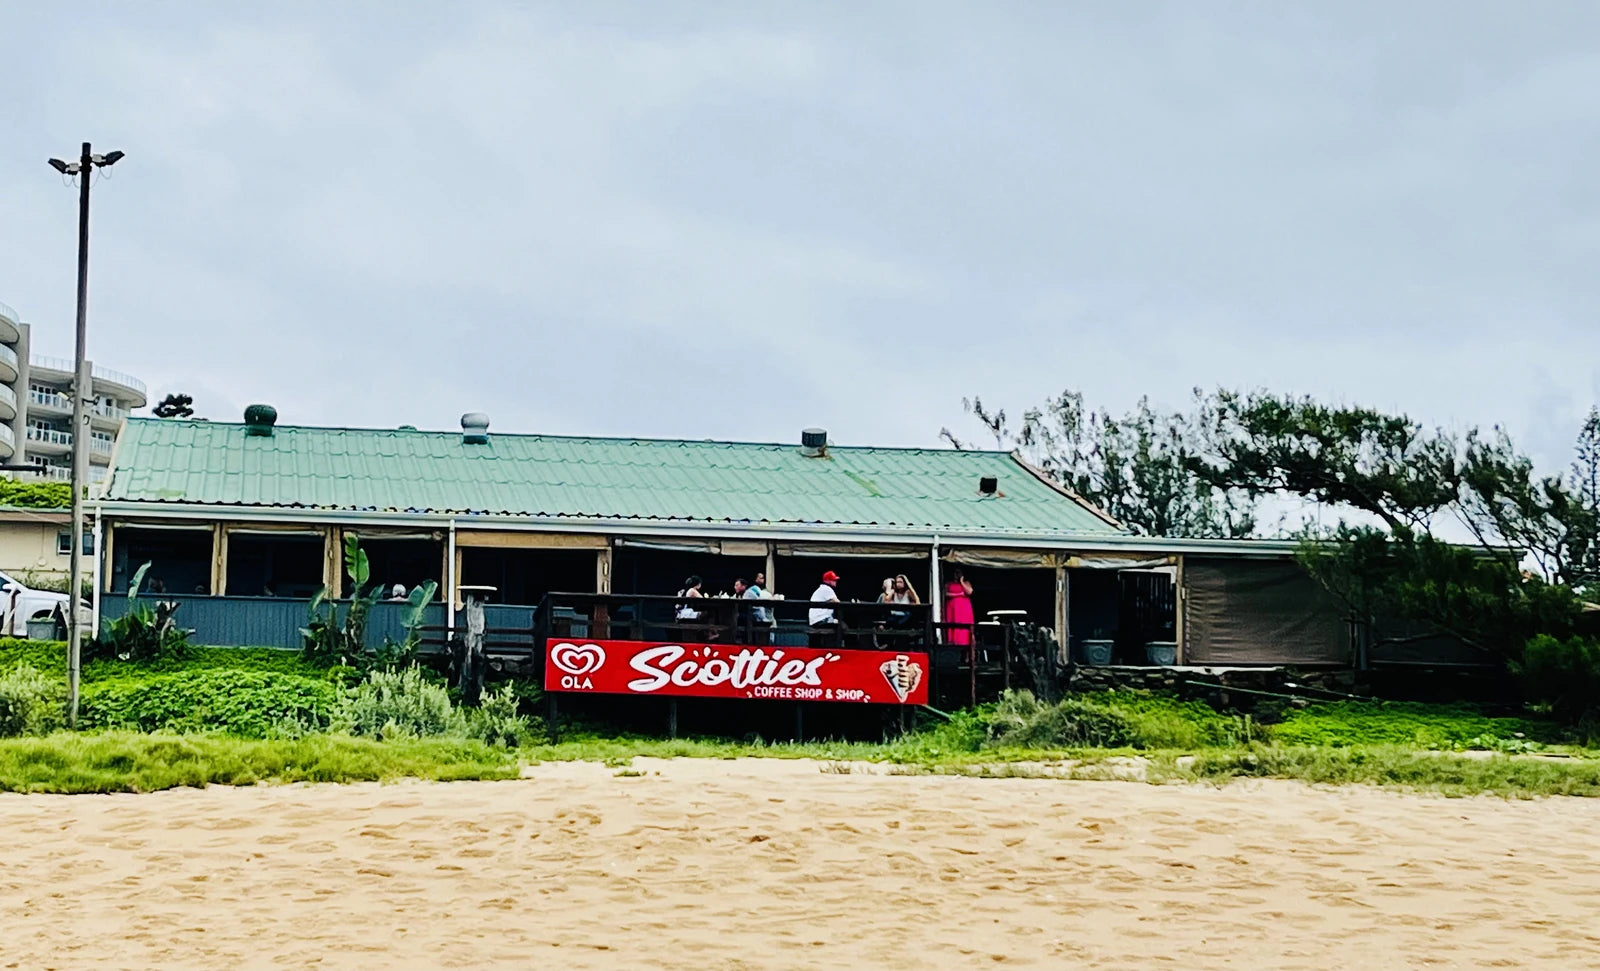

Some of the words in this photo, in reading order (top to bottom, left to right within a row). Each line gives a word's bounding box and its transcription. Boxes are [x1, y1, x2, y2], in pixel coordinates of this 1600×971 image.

[628, 645, 827, 692] Scotties
[561, 676, 594, 689] OLA
[754, 686, 792, 698] COFFEE
[795, 688, 823, 699] SHOP
[825, 689, 833, 699] &
[836, 689, 864, 700] SHOP
